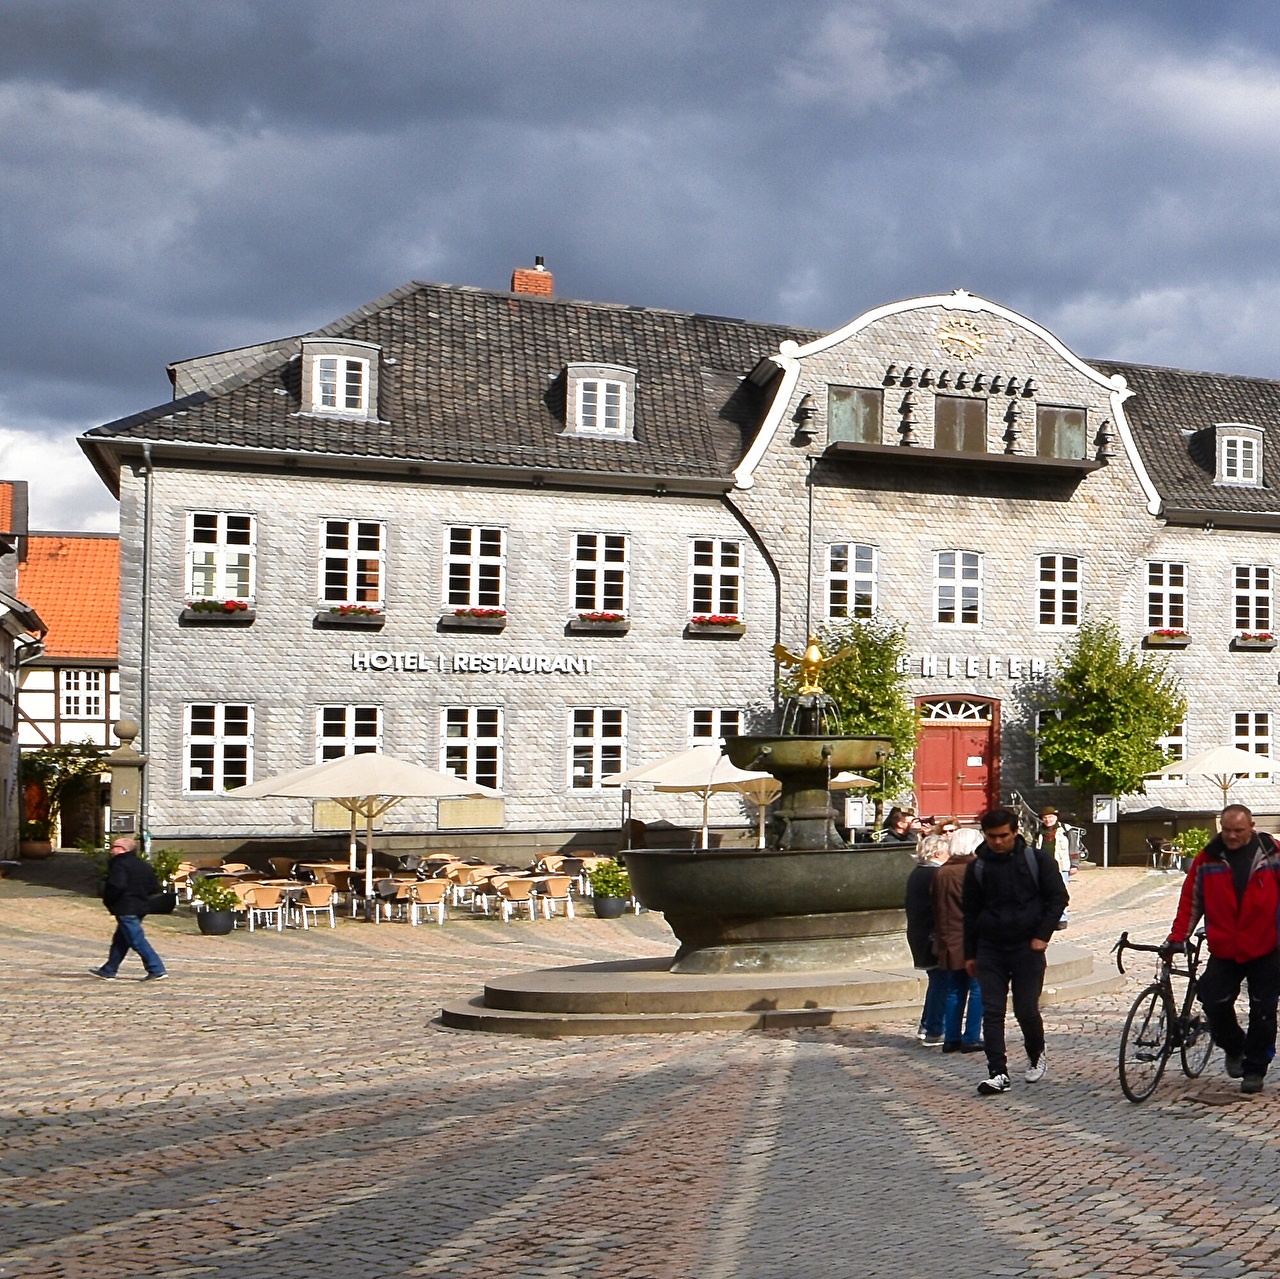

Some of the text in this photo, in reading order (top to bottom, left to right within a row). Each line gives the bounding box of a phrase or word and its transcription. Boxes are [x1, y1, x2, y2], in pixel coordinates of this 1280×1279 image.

[352, 651, 594, 674] HOTEL RESTAURANT
[896, 653, 1047, 678] CHIEFER
